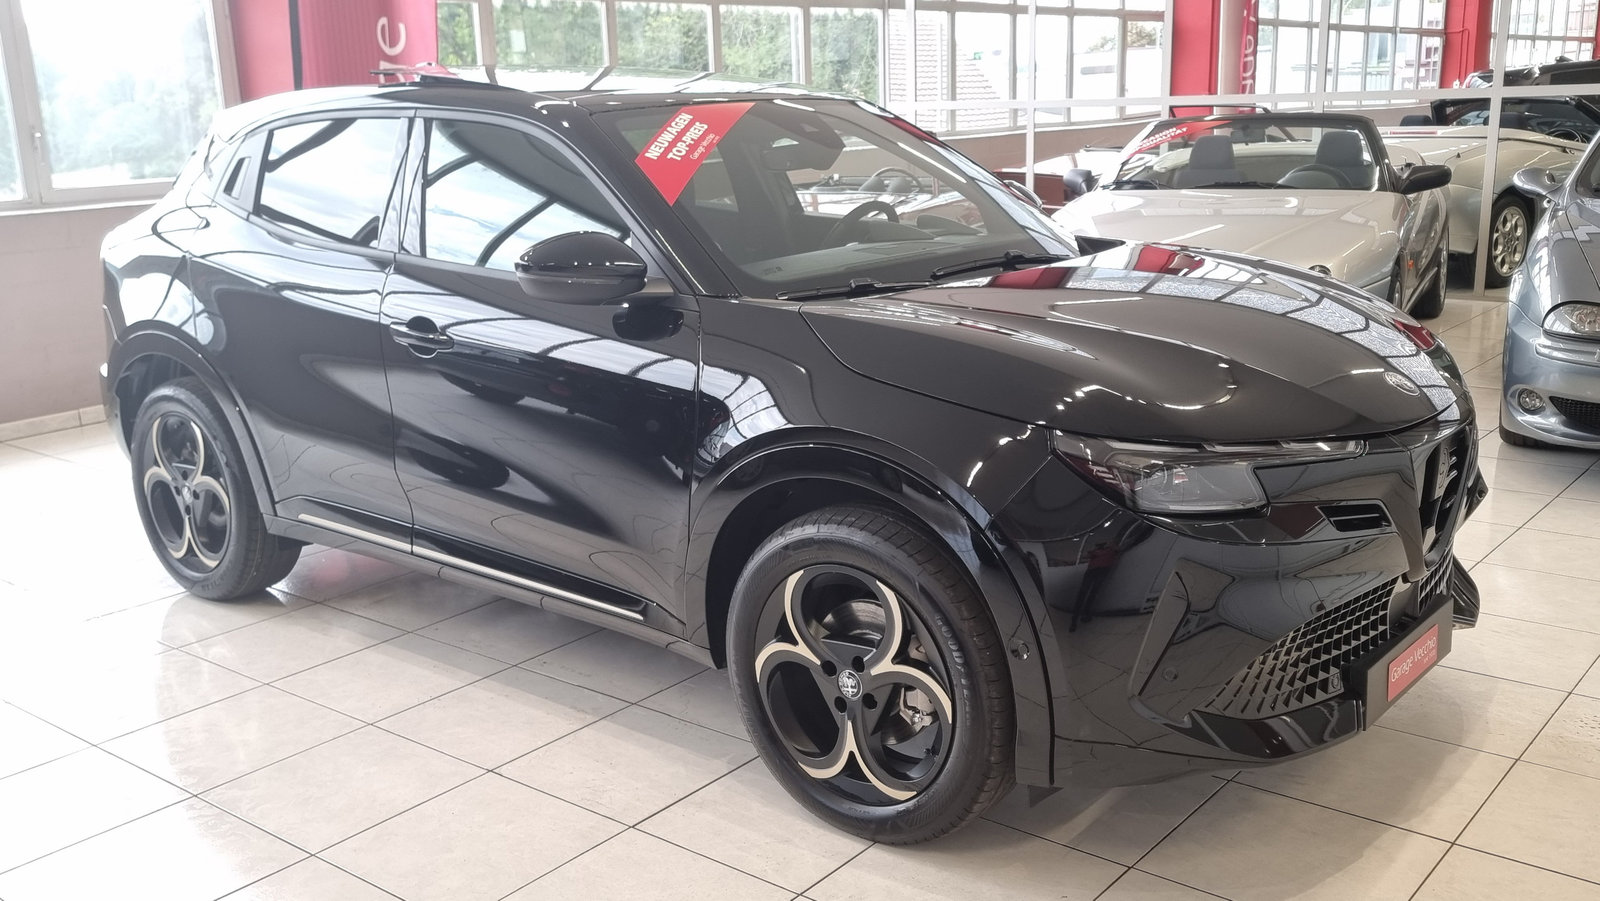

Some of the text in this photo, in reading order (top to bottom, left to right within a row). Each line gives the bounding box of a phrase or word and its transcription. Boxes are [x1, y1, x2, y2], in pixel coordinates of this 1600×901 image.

[644, 112, 694, 160] NEUWAGEN
[666, 121, 708, 161] TOP-PREIS
[1391, 656, 1413, 682] Garage
[1413, 636, 1437, 662] Vecchio
